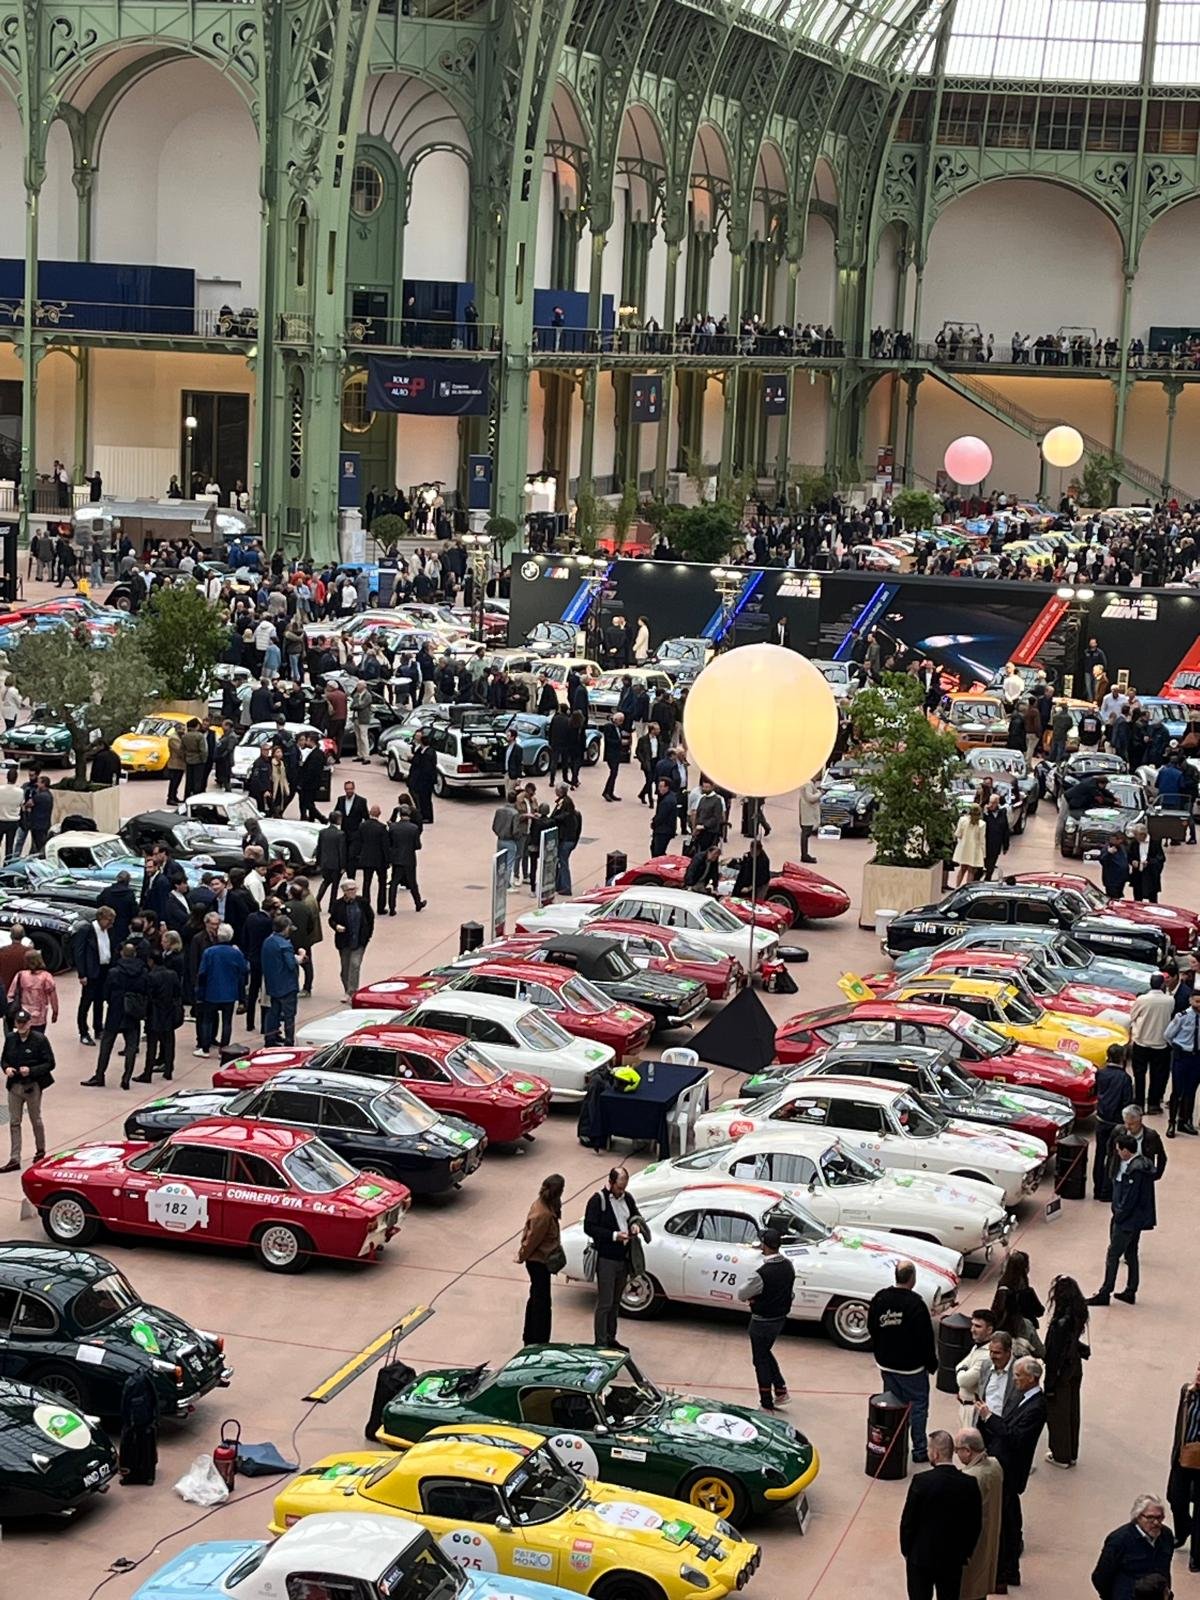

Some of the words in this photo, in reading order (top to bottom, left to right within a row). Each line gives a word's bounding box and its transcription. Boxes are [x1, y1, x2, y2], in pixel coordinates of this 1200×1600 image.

[913, 920, 937, 935] alfa
[226, 1188, 280, 1204] CONRERO
[281, 1195, 303, 1208] GTA
[165, 1202, 188, 1216] 182
[712, 1269, 737, 1286] 178
